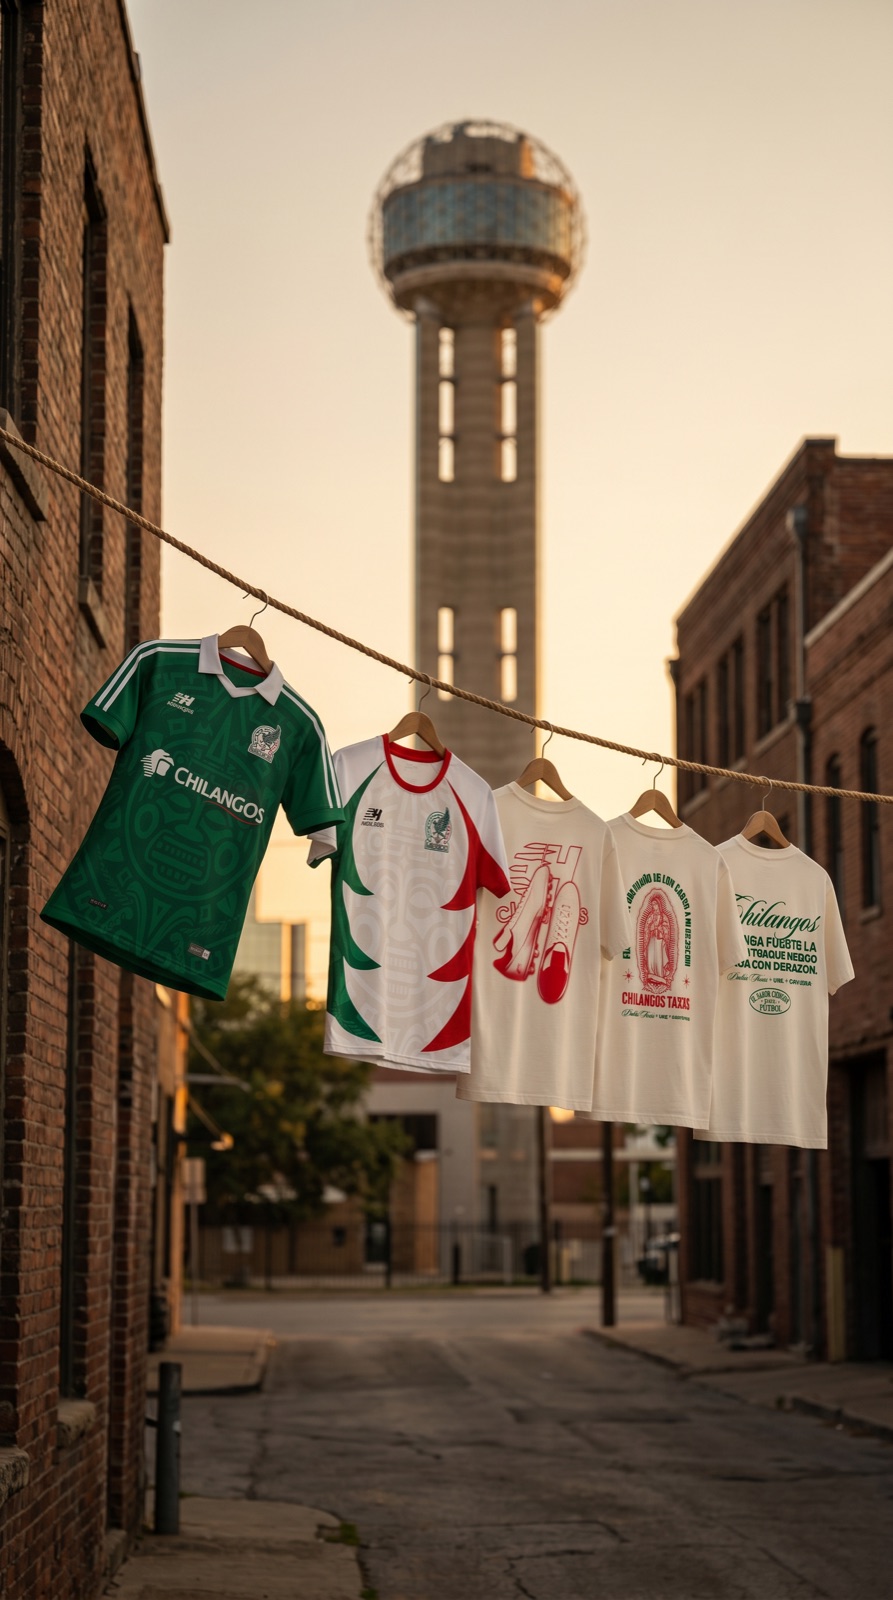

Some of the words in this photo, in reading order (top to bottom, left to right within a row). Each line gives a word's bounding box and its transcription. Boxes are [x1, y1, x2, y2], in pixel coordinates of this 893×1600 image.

[174, 766, 265, 824] CHILANGOS
[804, 941, 817, 953] LA
[751, 959, 771, 970] CON
[773, 961, 818, 975] DERAZON.
[621, 991, 666, 1008] CHILANGOS
